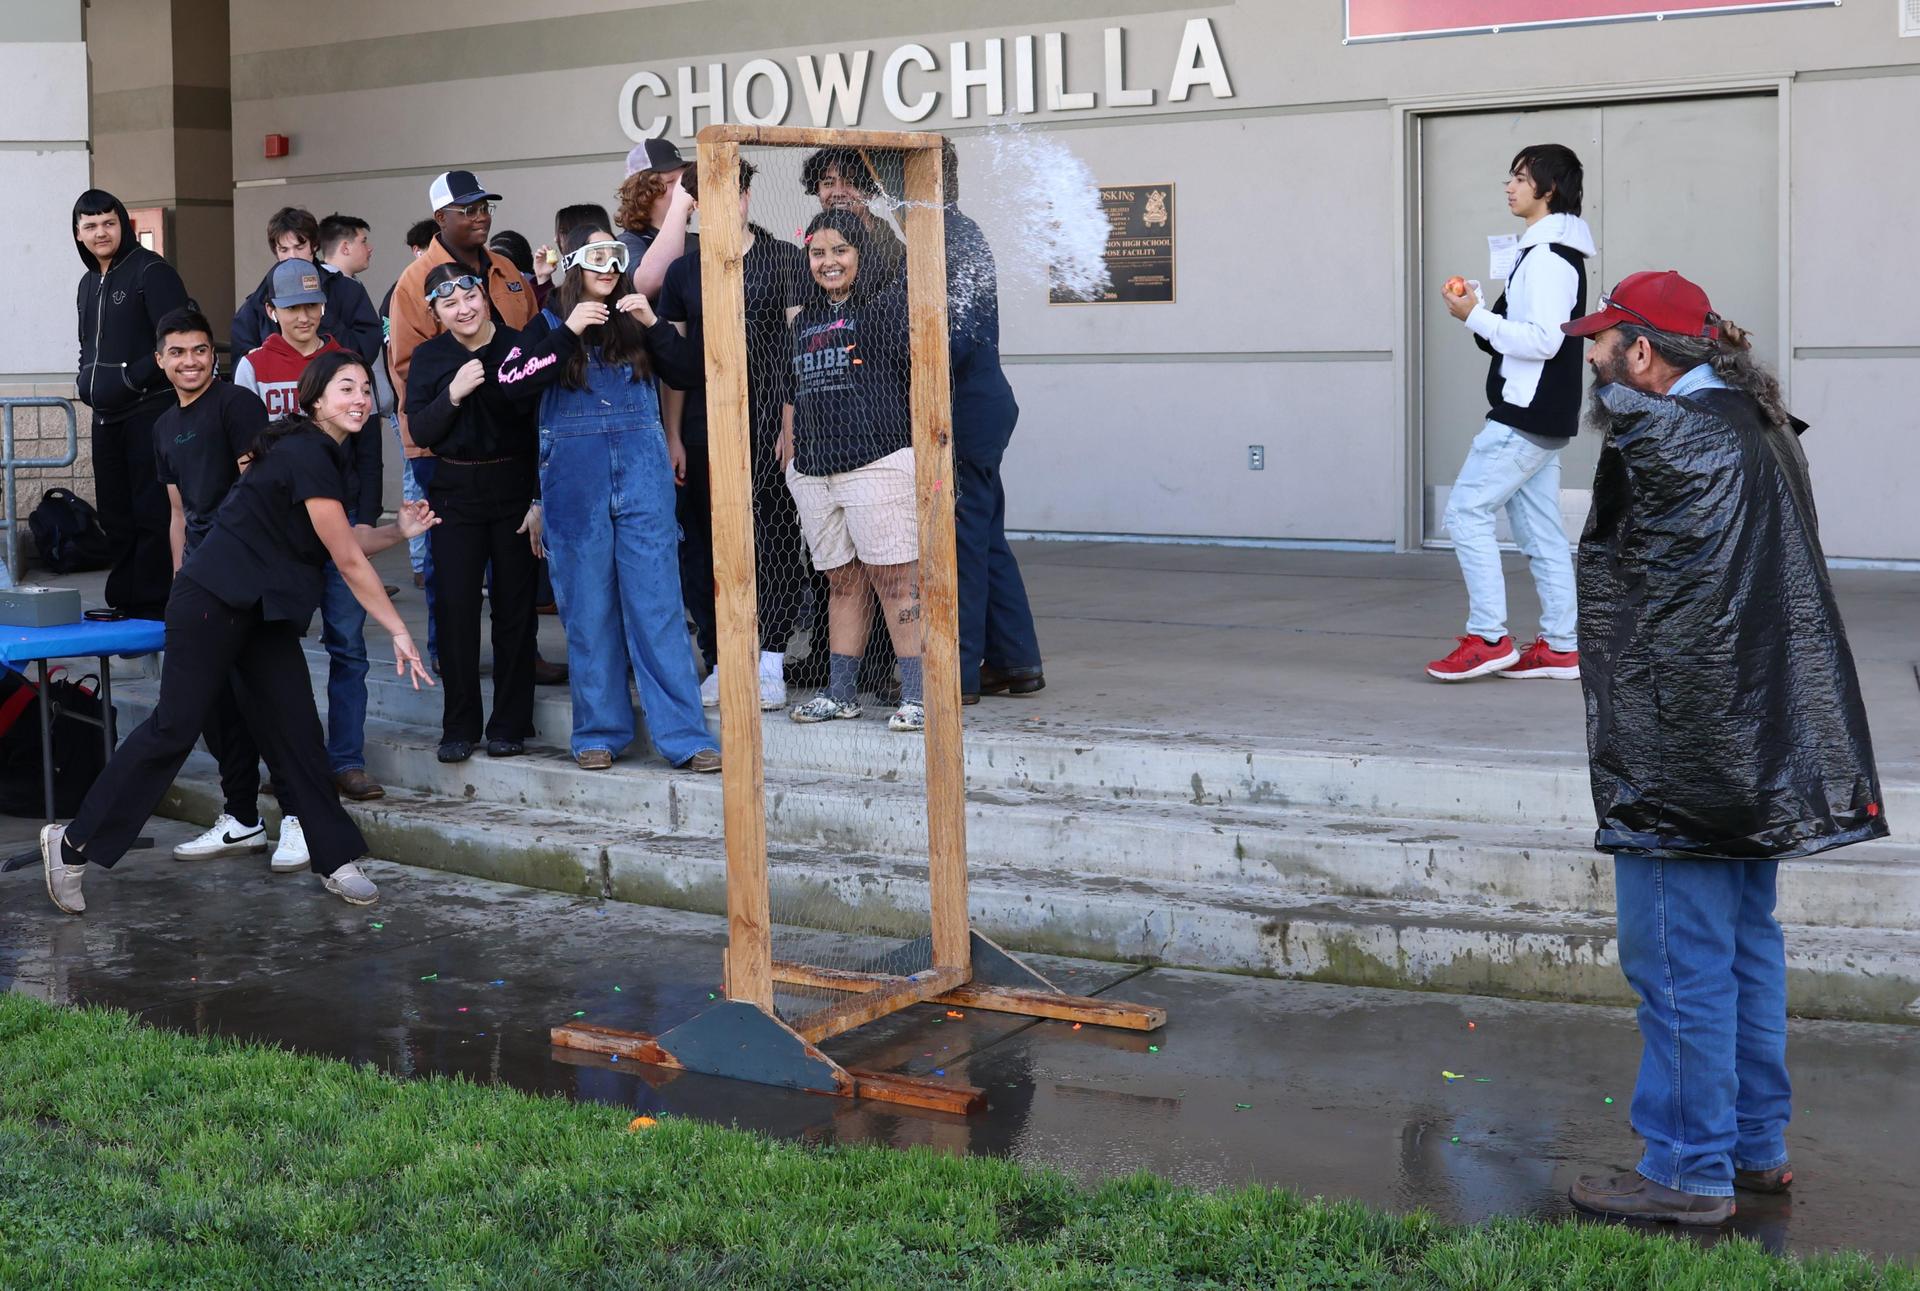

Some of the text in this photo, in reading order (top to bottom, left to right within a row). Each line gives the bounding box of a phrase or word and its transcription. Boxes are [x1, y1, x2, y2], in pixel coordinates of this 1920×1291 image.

[618, 17, 1235, 143] CHOWCHILLA
[1099, 191, 1135, 201] OSKINS
[1122, 240, 1141, 248] HIGH
[1142, 239, 1169, 247] SCHOOL
[1122, 249, 1155, 257] FACILITY
[793, 348, 849, 375] TRIBE
